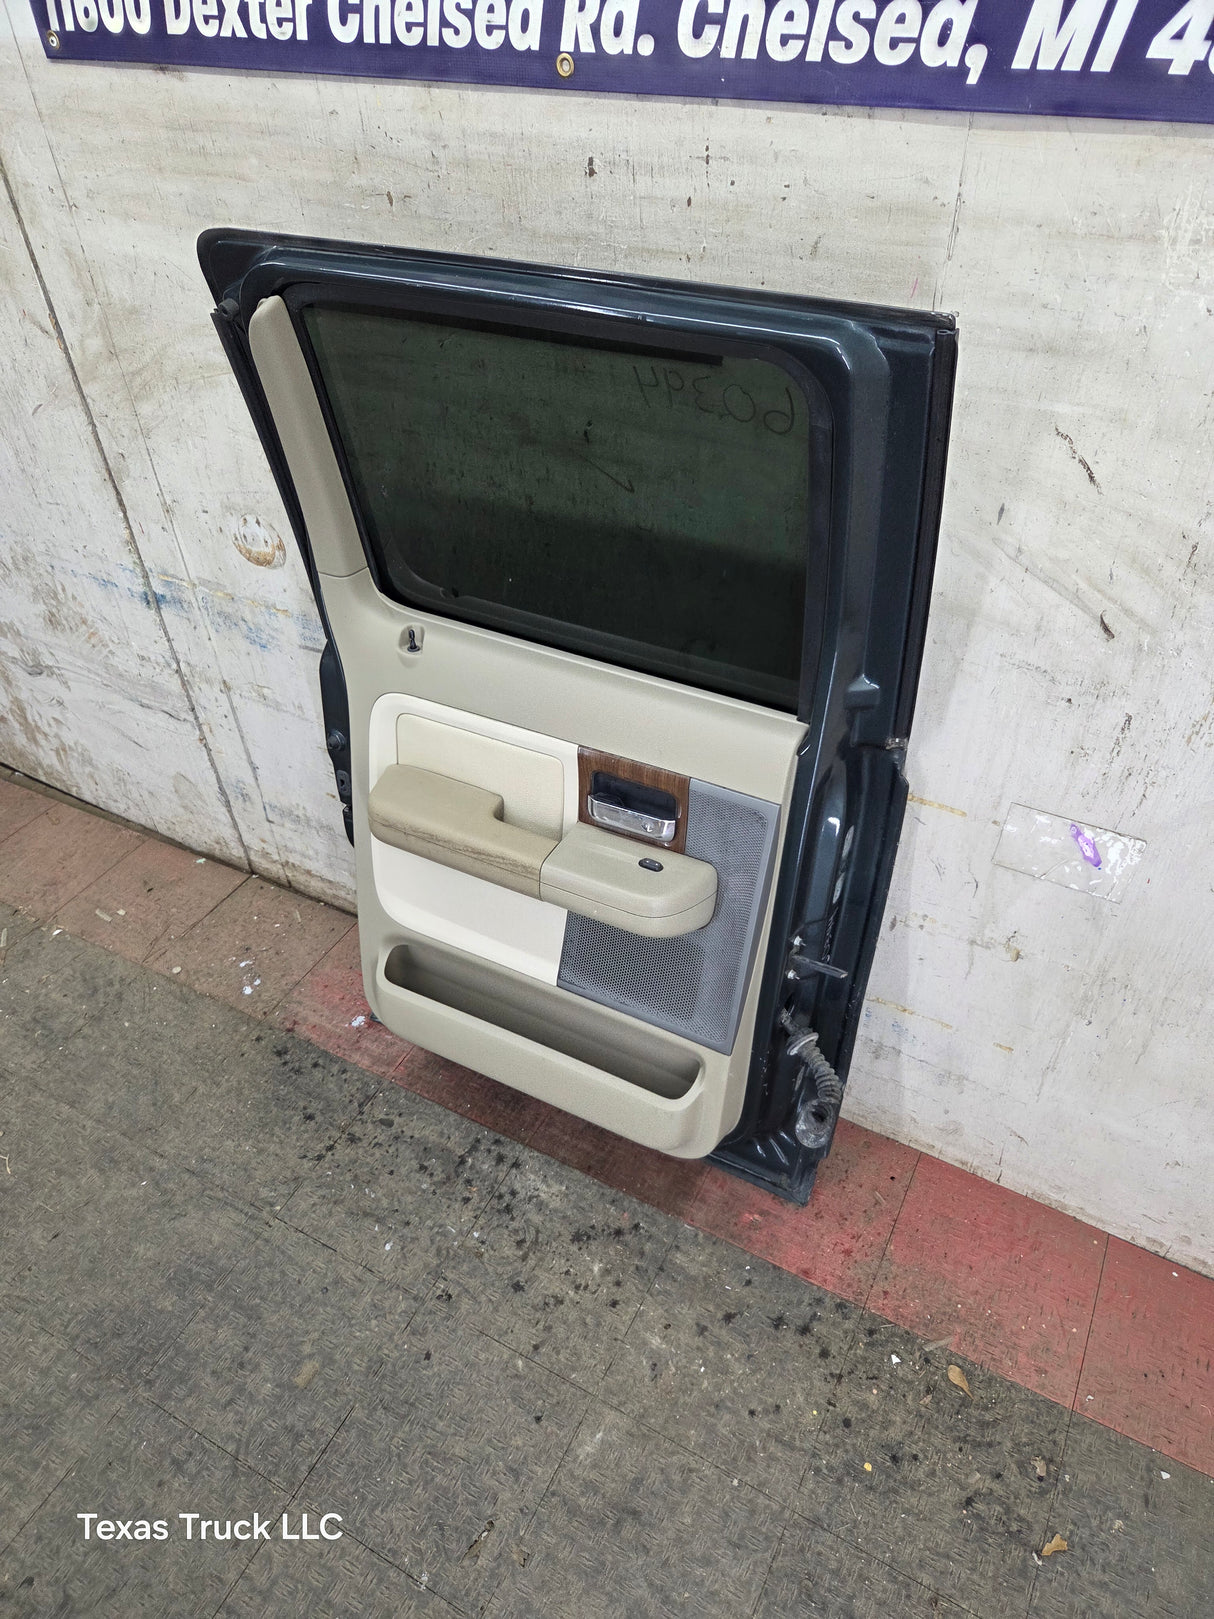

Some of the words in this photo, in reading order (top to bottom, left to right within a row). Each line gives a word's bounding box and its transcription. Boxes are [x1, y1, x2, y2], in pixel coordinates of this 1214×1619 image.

[163, 0, 312, 41] Dexter
[327, 0, 544, 51] Chelsea
[560, 0, 655, 56] Rd.
[677, 0, 988, 85] Chelsea,
[1011, 0, 1140, 73] MI
[1146, 0, 1214, 76] 4
